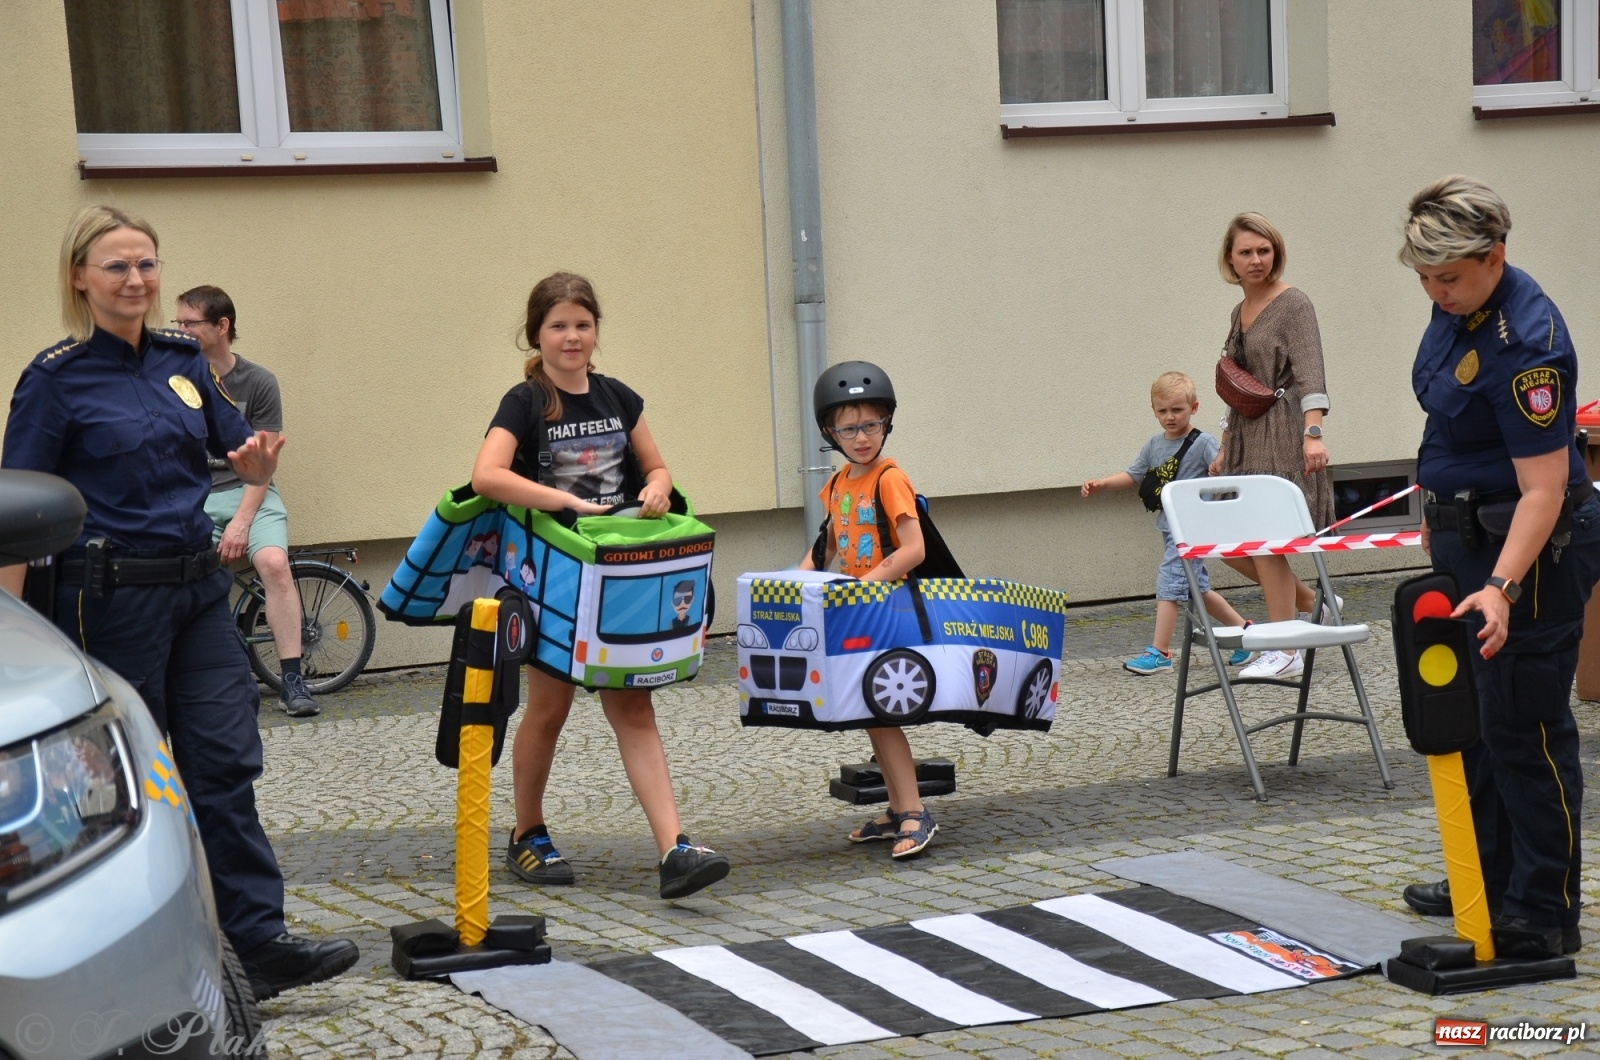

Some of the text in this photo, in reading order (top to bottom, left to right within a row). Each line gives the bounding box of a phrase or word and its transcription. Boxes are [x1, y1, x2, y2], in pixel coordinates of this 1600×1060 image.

[1519, 377, 1555, 392] MIEJSKA
[548, 423, 577, 441] THAT
[603, 541, 713, 562] GOTOWI DO DROGI
[753, 609, 801, 622] STRAŻ MIEJSKA
[943, 619, 1049, 650] STRAŻ MIEJSKA 986
[636, 672, 675, 684] RACIBÓRZ
